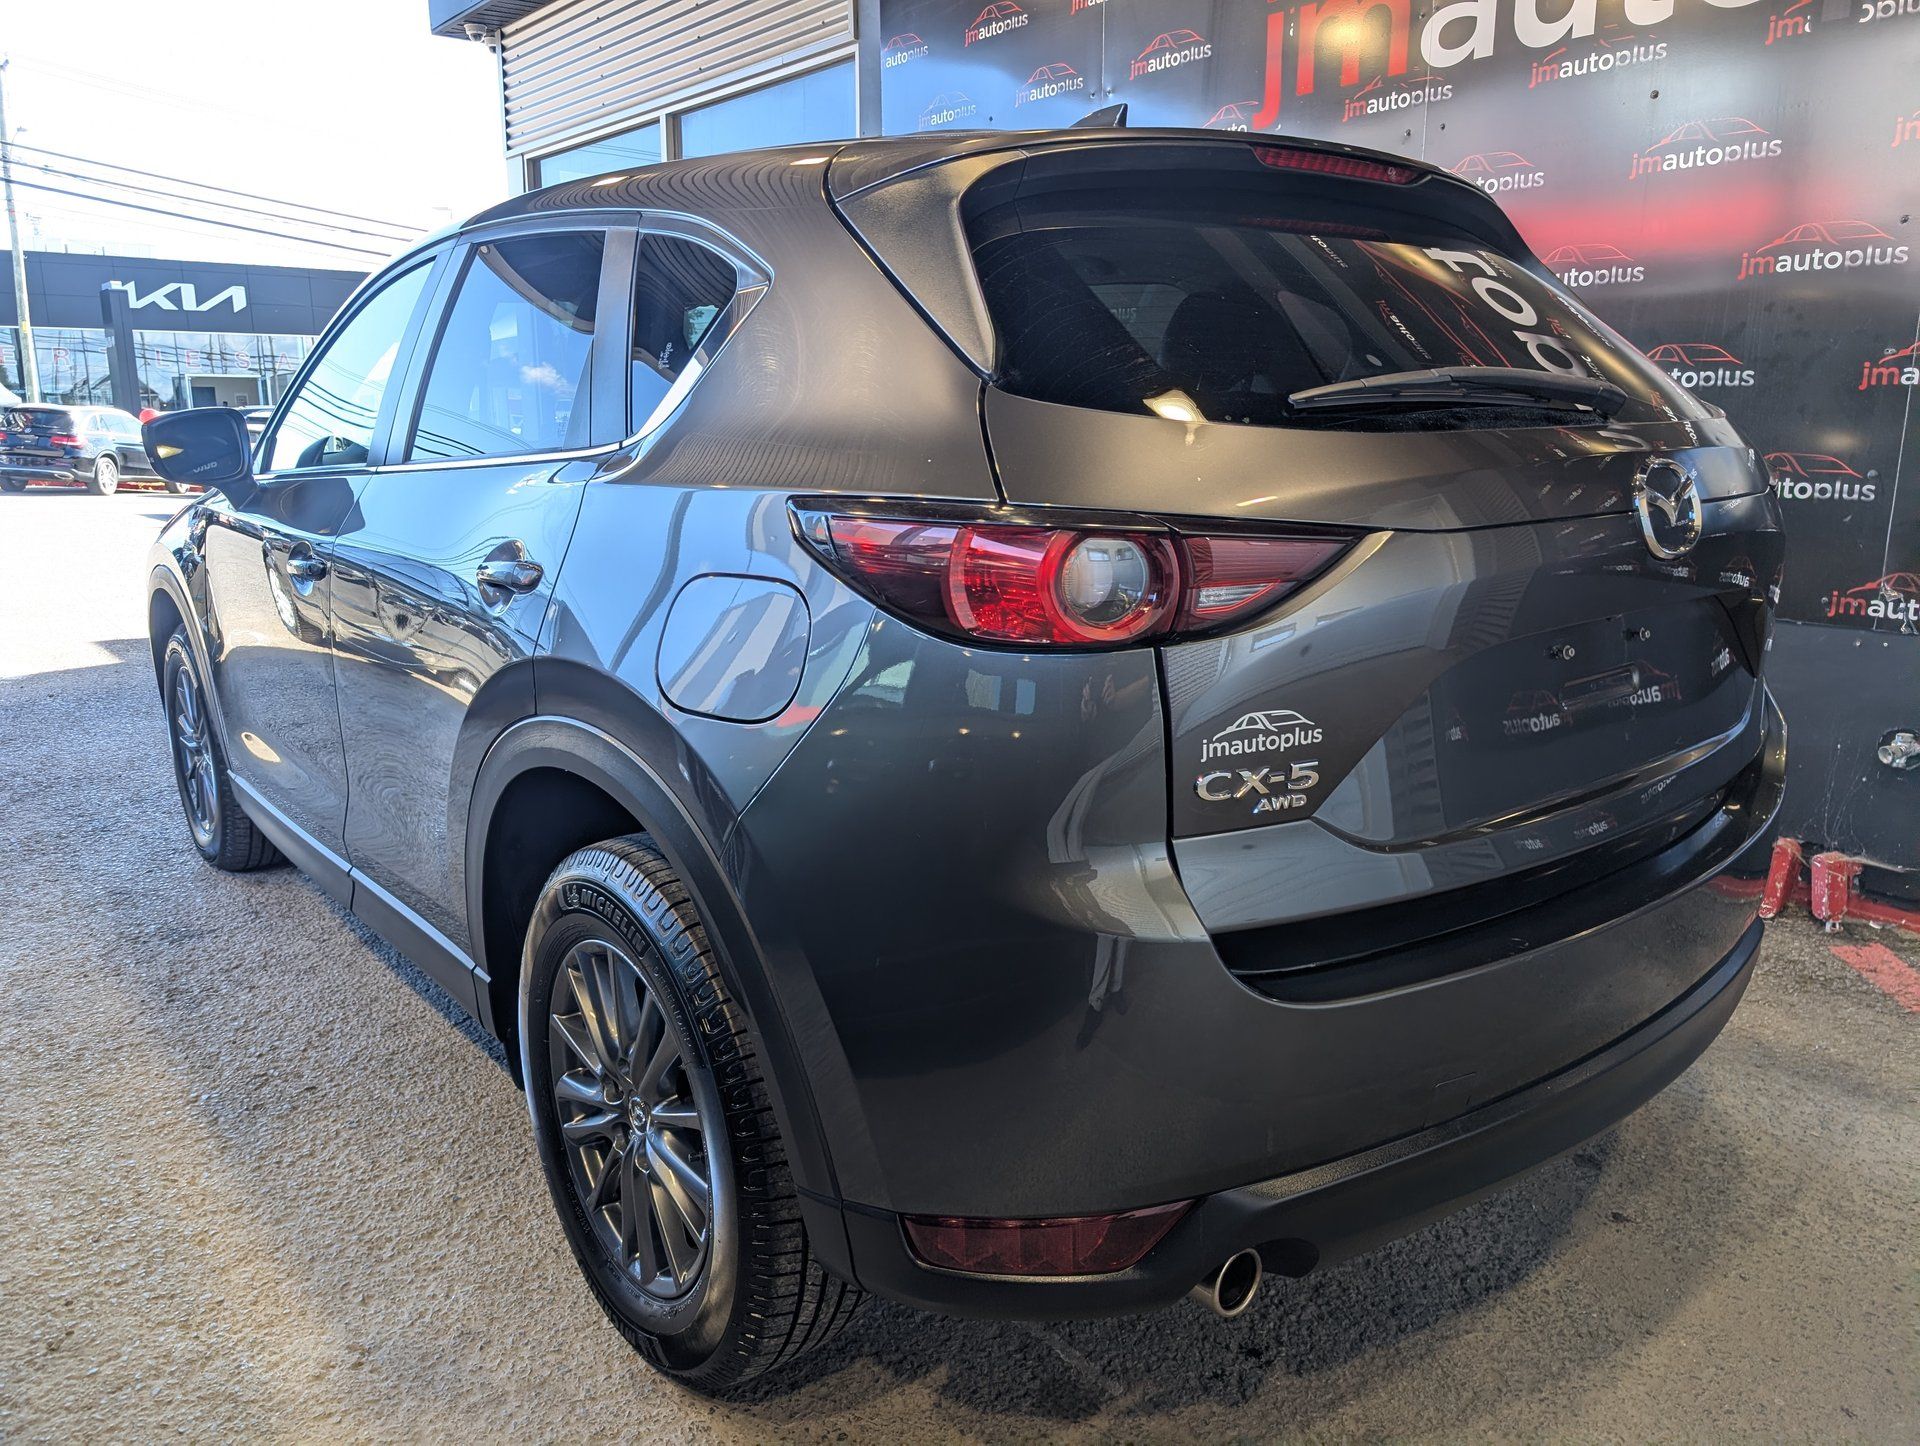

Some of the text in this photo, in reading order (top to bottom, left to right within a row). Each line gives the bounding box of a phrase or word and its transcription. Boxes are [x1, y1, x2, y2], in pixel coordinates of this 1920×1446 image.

[965, 13, 1028, 47] jmautoplus
[1129, 42, 1212, 81] jmautoplus
[1529, 40, 1667, 89] jmautoplus
[1015, 76, 1083, 108] jmautoplus
[1342, 83, 1453, 123] jmautoplus
[1629, 137, 1783, 181] jmautoplus
[1738, 245, 1909, 281] jmautoplus
[121, 280, 247, 313] KIA
[1201, 727, 1323, 762] jmautoplus
[1193, 759, 1320, 801] CX-5
[1252, 793, 1308, 814] AWD
[581, 888, 646, 952] MICHELIN
